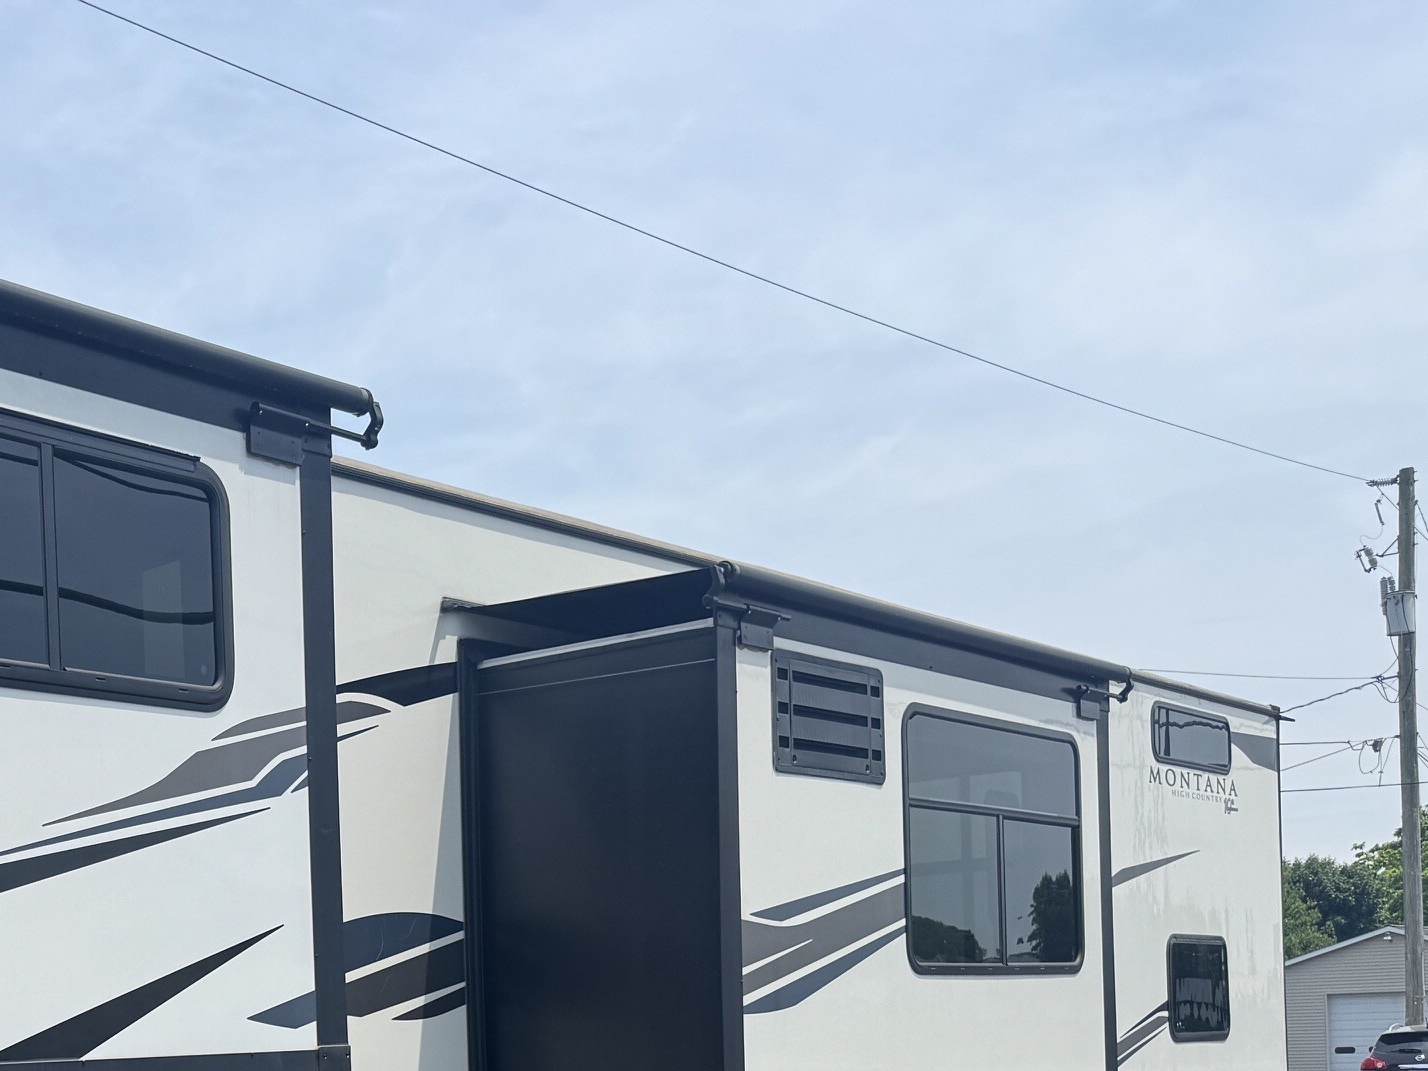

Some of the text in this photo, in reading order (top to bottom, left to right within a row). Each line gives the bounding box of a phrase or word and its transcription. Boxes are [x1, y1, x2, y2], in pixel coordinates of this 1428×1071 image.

[1149, 765, 1238, 797] MONTANA
[1171, 789, 1190, 799] HIGH
[1192, 792, 1223, 803] COUNTRY
